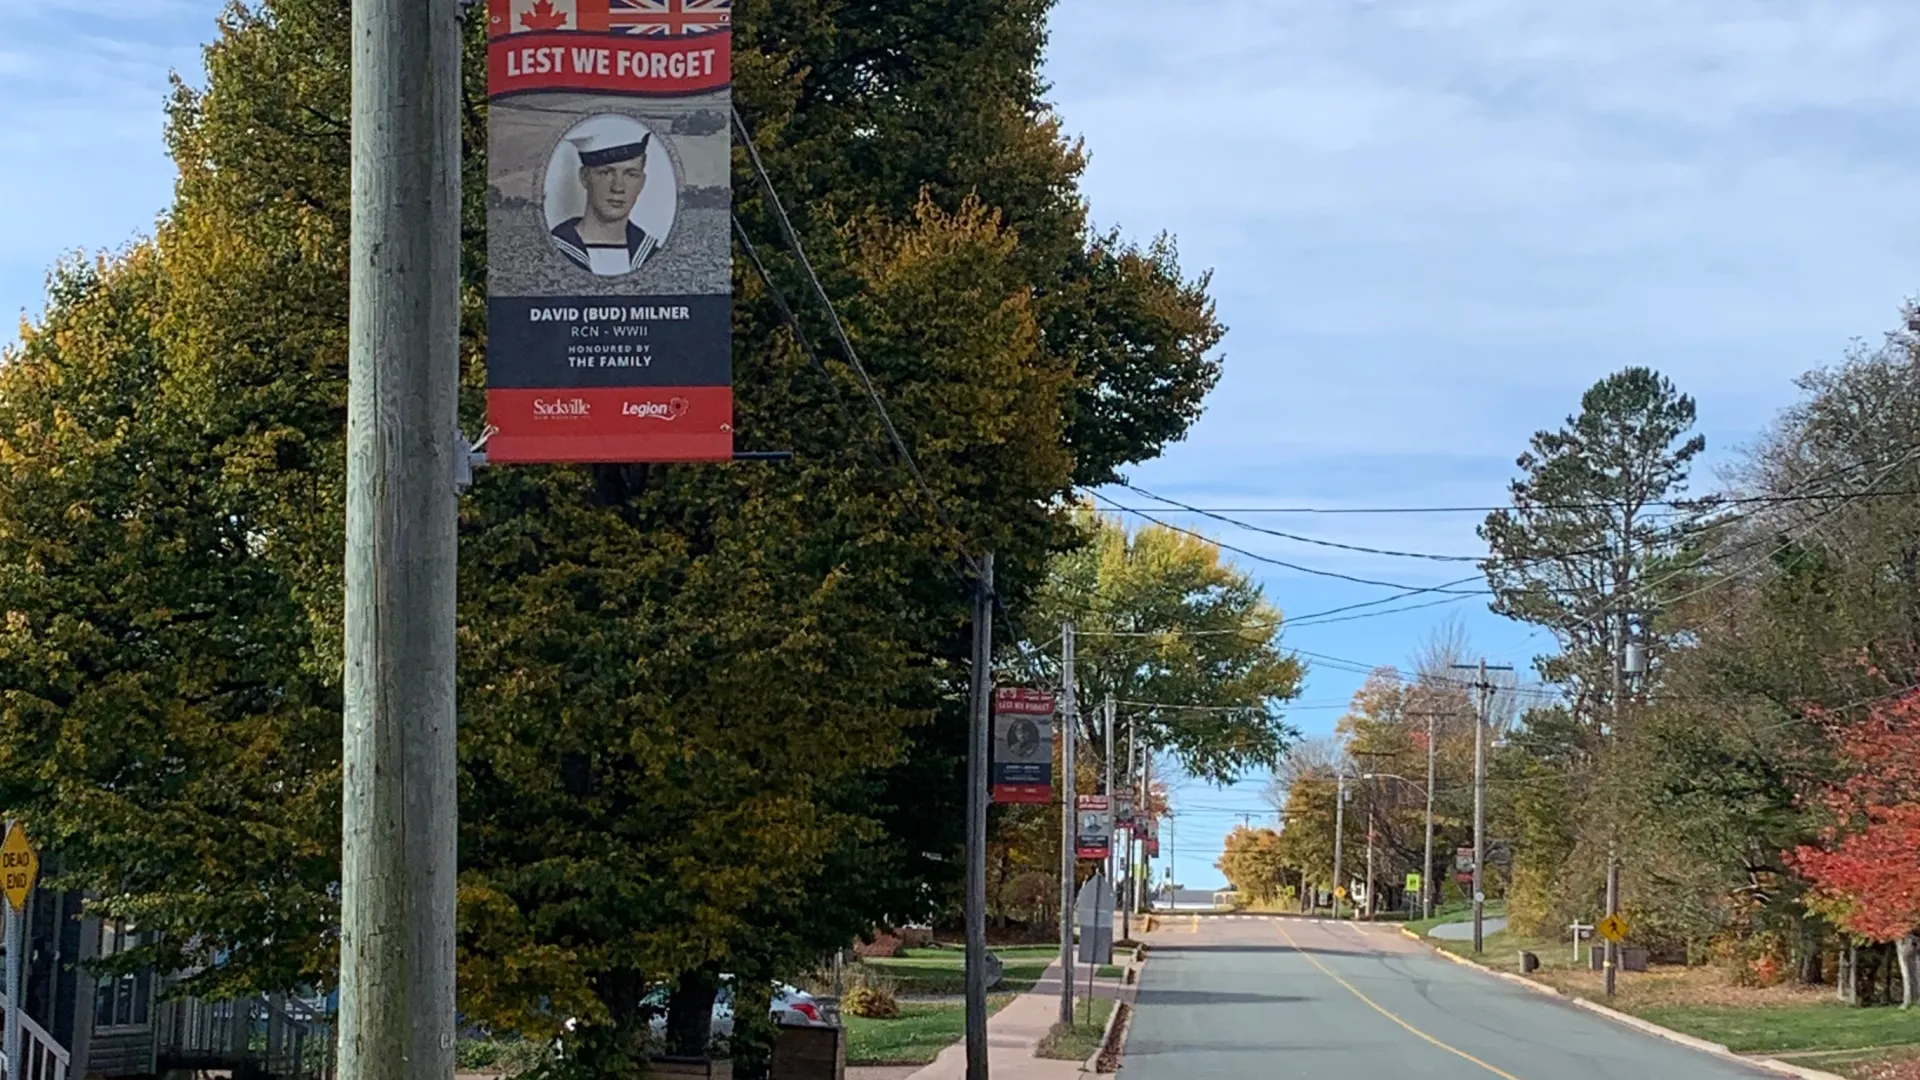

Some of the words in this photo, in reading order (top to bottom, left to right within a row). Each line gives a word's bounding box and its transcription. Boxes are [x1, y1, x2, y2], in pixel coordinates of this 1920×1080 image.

[508, 48, 565, 76] LEST
[571, 48, 610, 74] WE
[617, 49, 715, 78] FORGET
[530, 308, 578, 321] DAVID
[583, 307, 626, 322] (BUD)
[630, 306, 690, 320] MILNER
[571, 326, 600, 337] RCN
[613, 326, 648, 336] WWII
[568, 346, 632, 354] HONOURED
[636, 344, 650, 352] BY
[568, 356, 594, 368] THE
[600, 356, 652, 367] FAMILY
[534, 398, 591, 414] Sackville
[622, 402, 668, 418] Legion
[3, 852, 30, 868] DEAD
[7, 872, 26, 888] END
